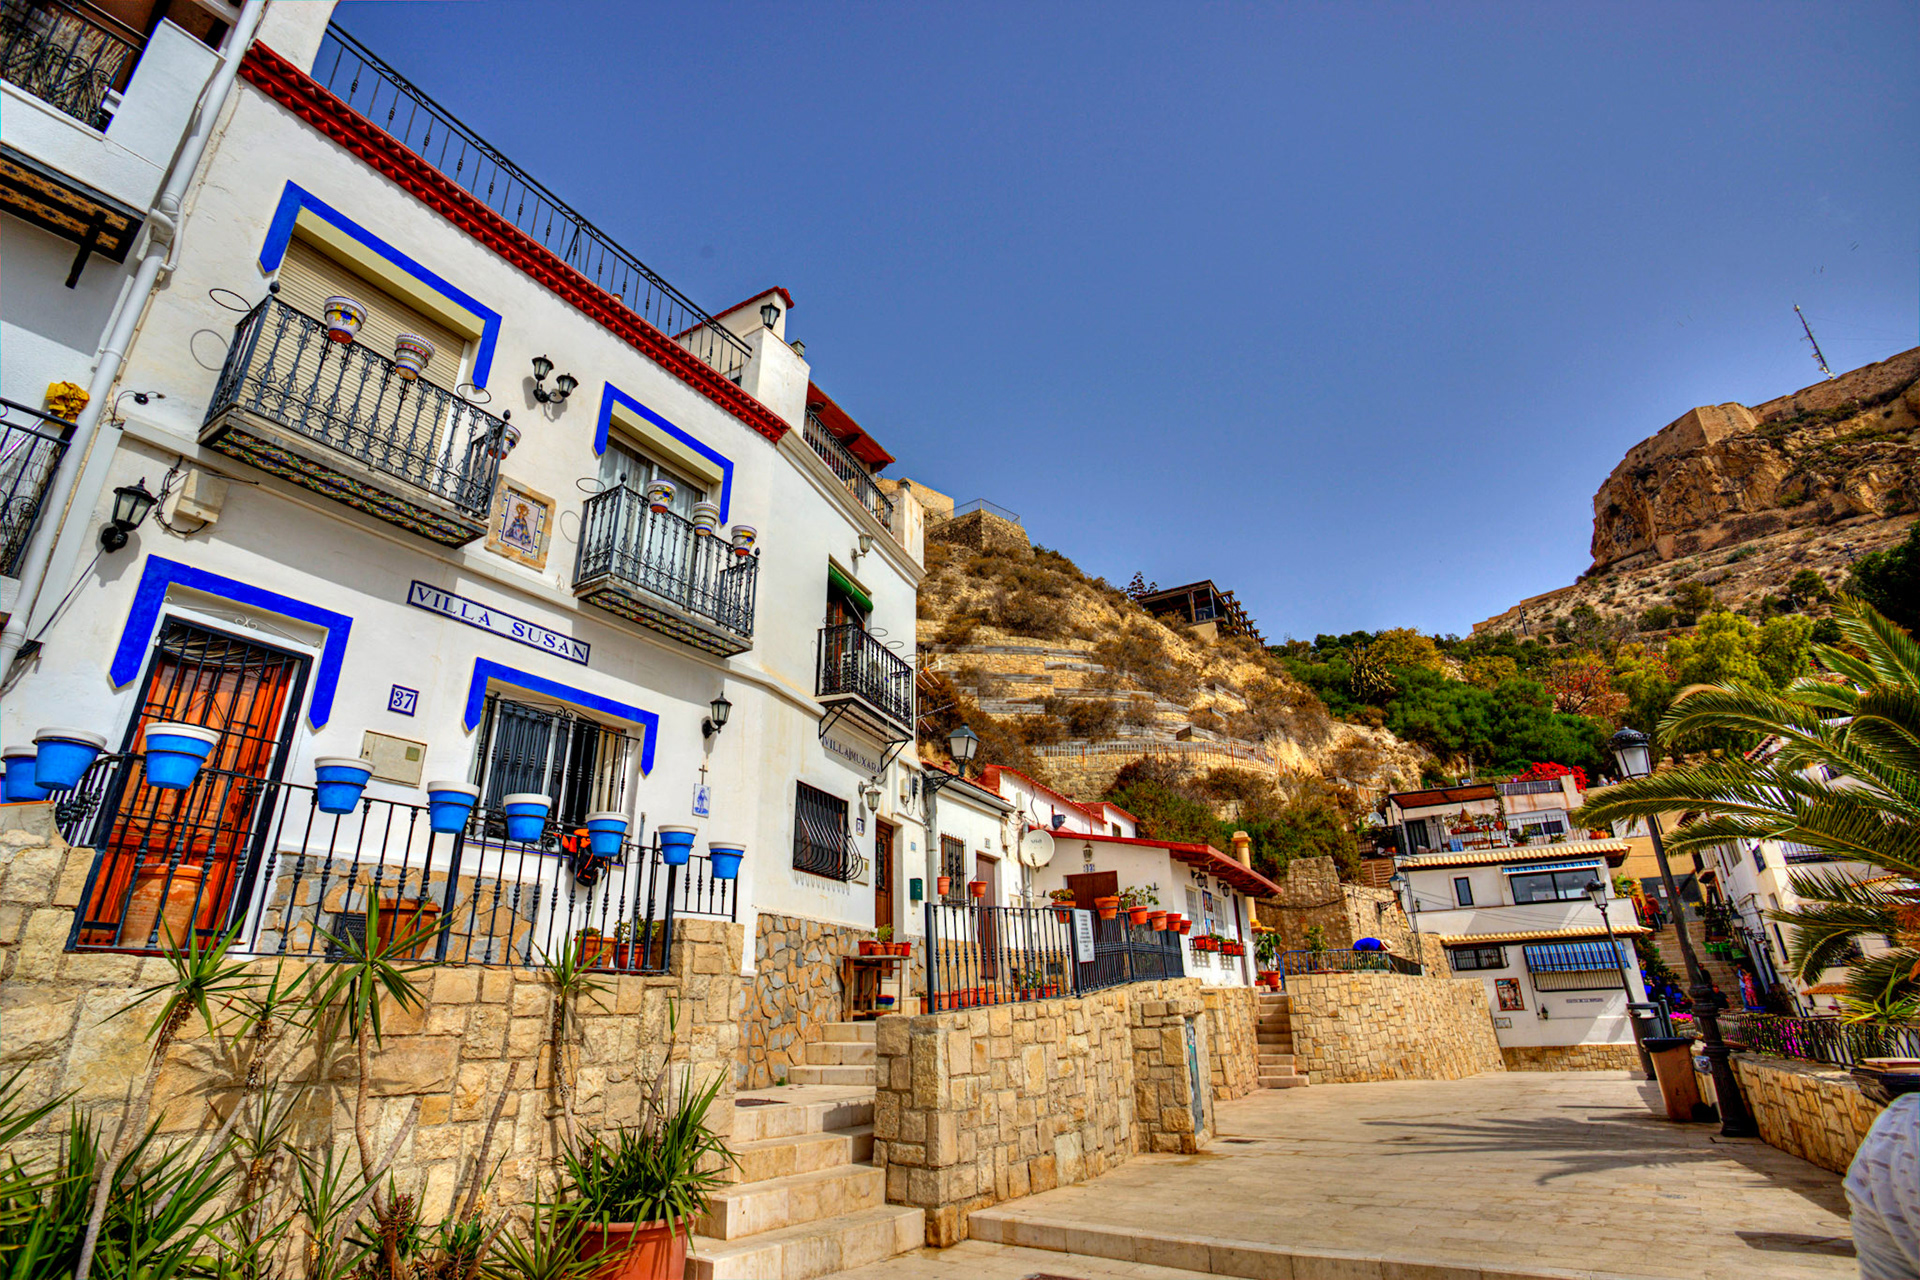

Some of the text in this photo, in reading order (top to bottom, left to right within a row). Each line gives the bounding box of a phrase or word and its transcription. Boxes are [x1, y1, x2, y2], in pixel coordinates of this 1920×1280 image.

[416, 586, 586, 660] VILLA SUSAN
[393, 690, 414, 709] 37
[824, 736, 849, 758] VILLA
